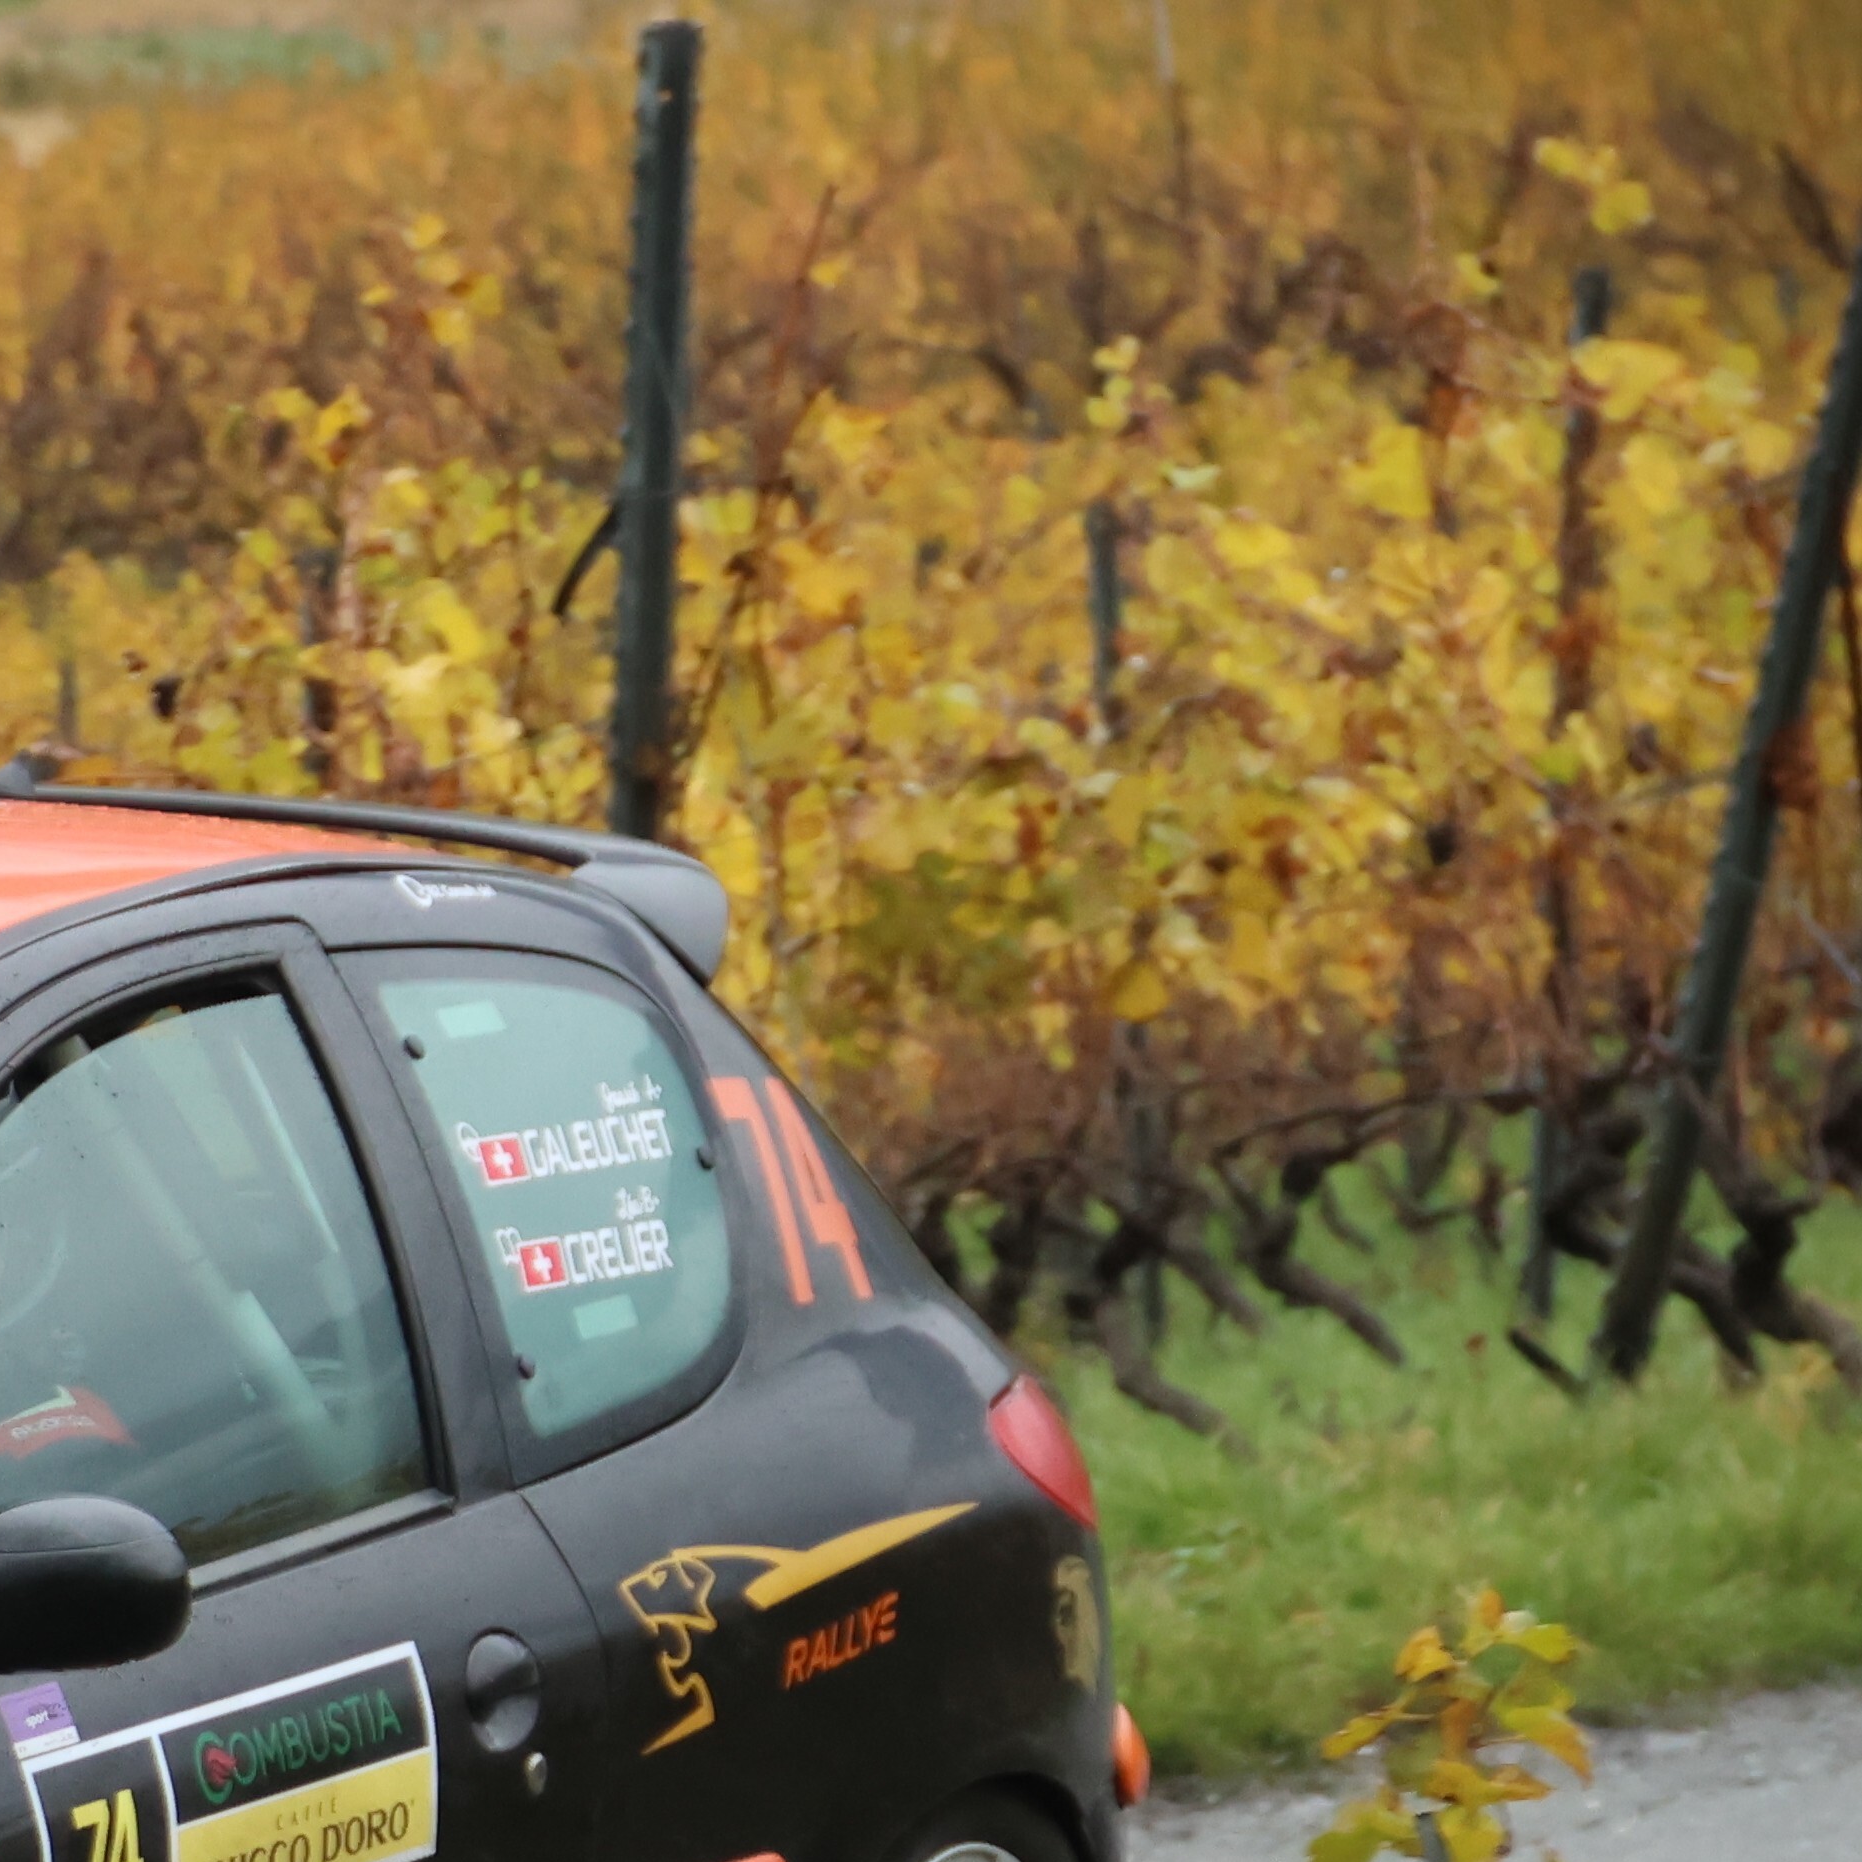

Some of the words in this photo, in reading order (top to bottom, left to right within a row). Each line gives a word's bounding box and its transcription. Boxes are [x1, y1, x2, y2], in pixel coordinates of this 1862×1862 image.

[524, 1109, 673, 1178] GALEUCHET
[706, 1076, 874, 1305] 74
[563, 1219, 674, 1285] CRELIER
[783, 1591, 899, 1691] RALLYE
[194, 1688, 403, 1804] COMBUSTIA
